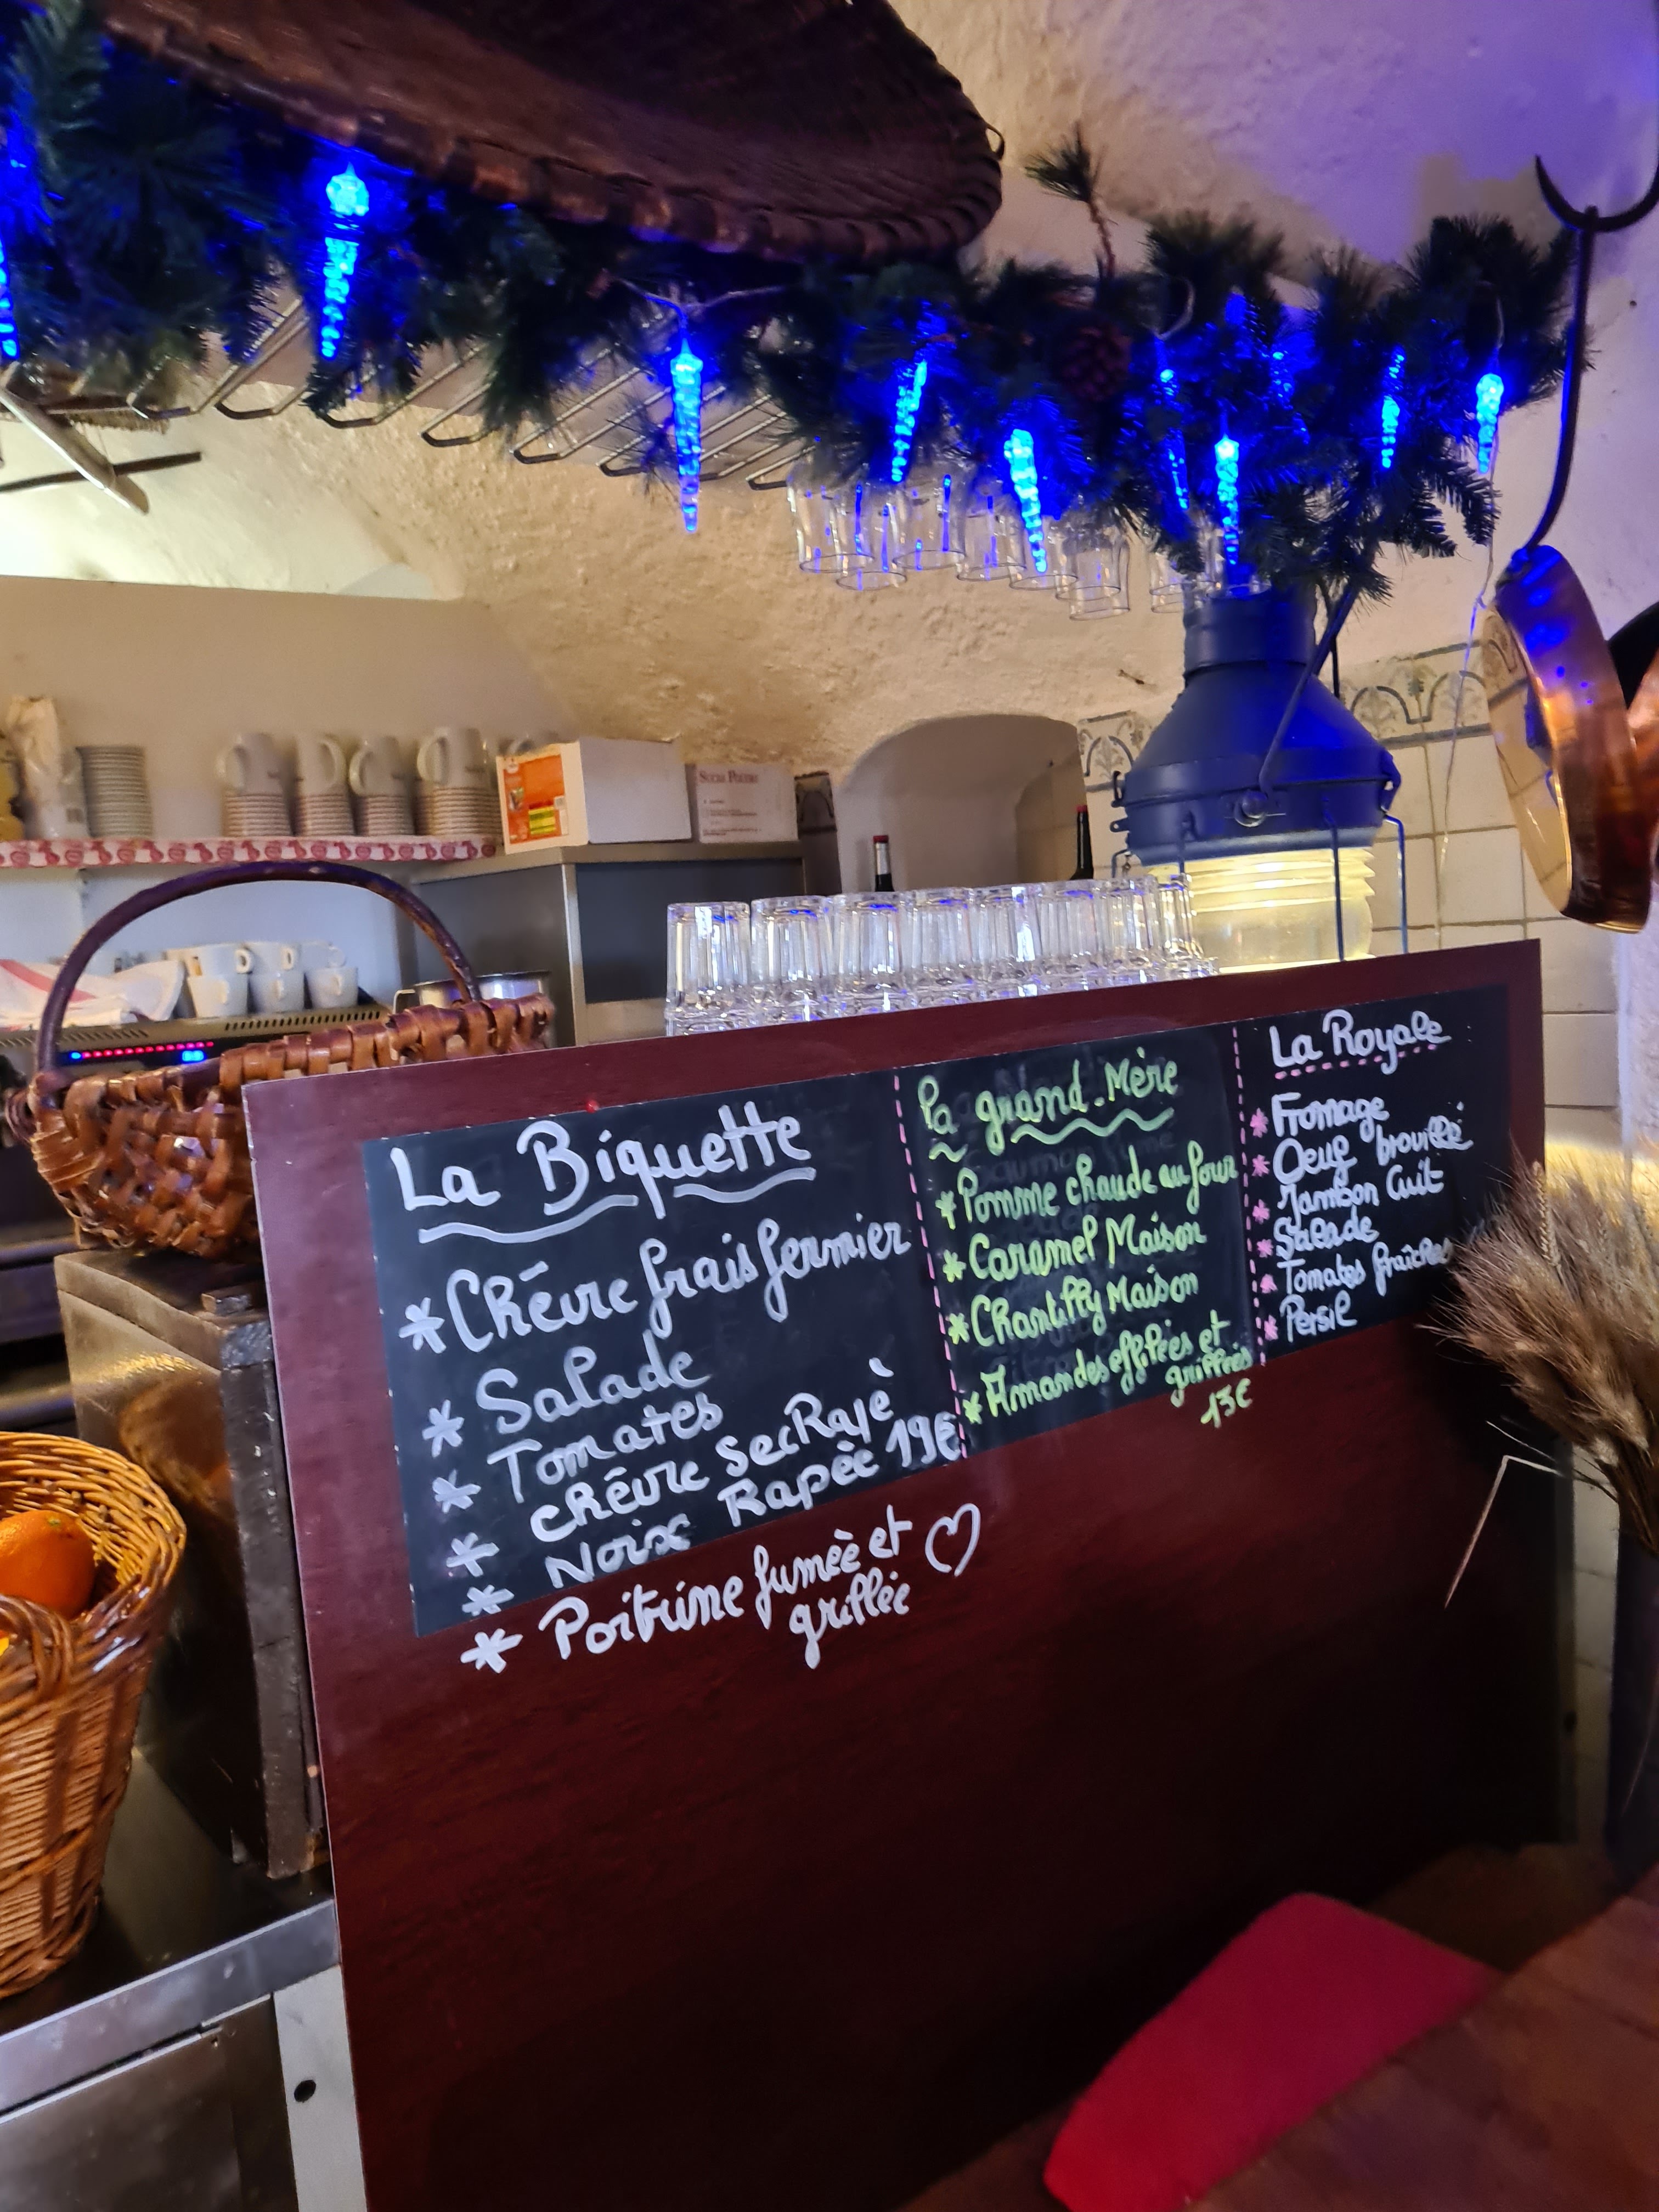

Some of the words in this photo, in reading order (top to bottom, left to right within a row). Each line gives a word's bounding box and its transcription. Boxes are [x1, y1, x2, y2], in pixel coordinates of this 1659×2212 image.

[1269, 1025, 1323, 1068] La
[1322, 1008, 1452, 1075] Royale
[1271, 1092, 1390, 1143] Fromage
[390, 1147, 501, 1211] La
[516, 1102, 811, 1220] Biquette
[956, 1166, 1060, 1224] Pomme
[1065, 1144, 1159, 1206] chaude
[1159, 1163, 1192, 1189] au
[1186, 1139, 1239, 1215] four
[1273, 1134, 1358, 1188] Oeuf
[1277, 1182, 1380, 1228] Jambon
[1386, 1156, 1444, 1201] Cuit
[968, 1214, 1098, 1282] Caramel
[1105, 1212, 1207, 1269] Maison
[1273, 1205, 1380, 1261] Salade
[639, 1232, 759, 1340] frais
[757, 1217, 912, 1323] fermier
[970, 1274, 1108, 1347] Chantilly
[1105, 1263, 1199, 1314] Maison
[1276, 1252, 1367, 1295] Tomates
[1279, 1289, 1358, 1343] Persil
[476, 1329, 712, 1434] Salade
[980, 1347, 1111, 1418] Amandes
[1198, 1309, 1231, 1354] et
[1200, 1378, 1254, 1429] 13€
[486, 1391, 724, 1504] Tomates
[544, 1513, 691, 1589] Noix
[885, 1410, 961, 1468] 19€
[538, 1575, 745, 1661] Poitrine
[868, 1504, 913, 1559] et
